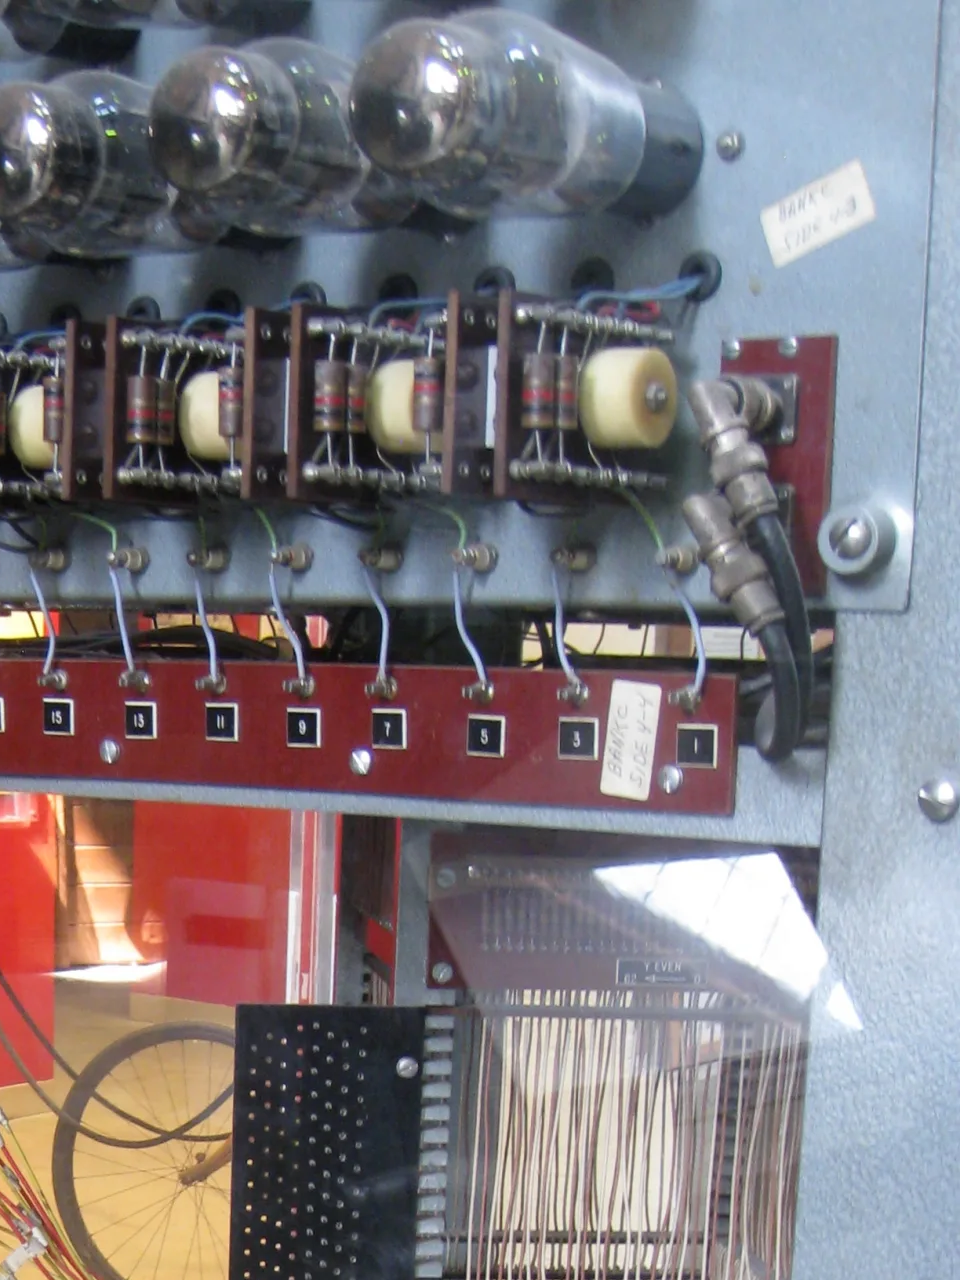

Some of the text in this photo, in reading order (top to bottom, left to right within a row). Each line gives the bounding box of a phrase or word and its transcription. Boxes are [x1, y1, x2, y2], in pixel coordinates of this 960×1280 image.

[51, 710, 63, 725] 15
[133, 713, 145, 729] 13
[216, 715, 225, 729] 11
[298, 719, 307, 735] 9
[384, 721, 391, 737] 7
[480, 728, 489, 745] 5
[573, 731, 581, 748] 3
[607, 716, 628, 778] BANK
[629, 740, 648, 788] SIDE
[654, 960, 682, 972] EVEN
